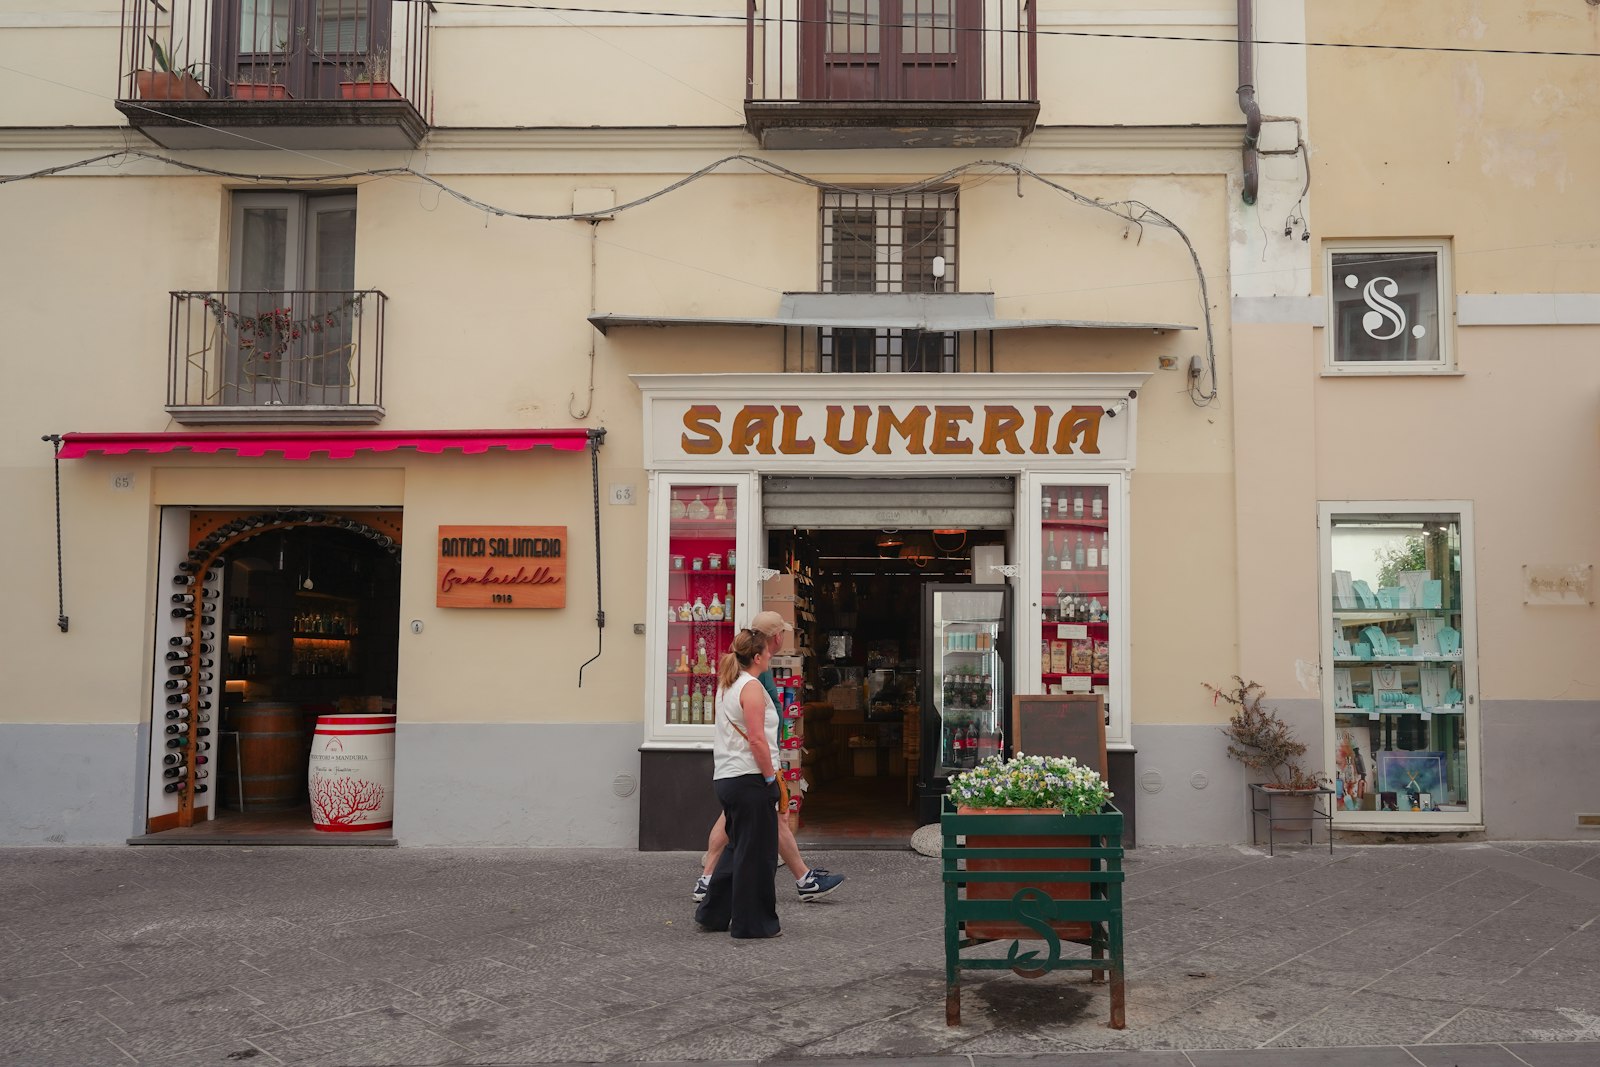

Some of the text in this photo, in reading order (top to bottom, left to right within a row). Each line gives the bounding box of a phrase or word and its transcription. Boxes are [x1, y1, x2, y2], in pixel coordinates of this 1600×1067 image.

[681, 405, 1106, 455] SALUMERIA
[115, 476, 129, 488] 65
[615, 488, 631, 500] 63
[442, 537, 561, 558] ANTICA SALUMERIA
[491, 594, 513, 604] 1918
